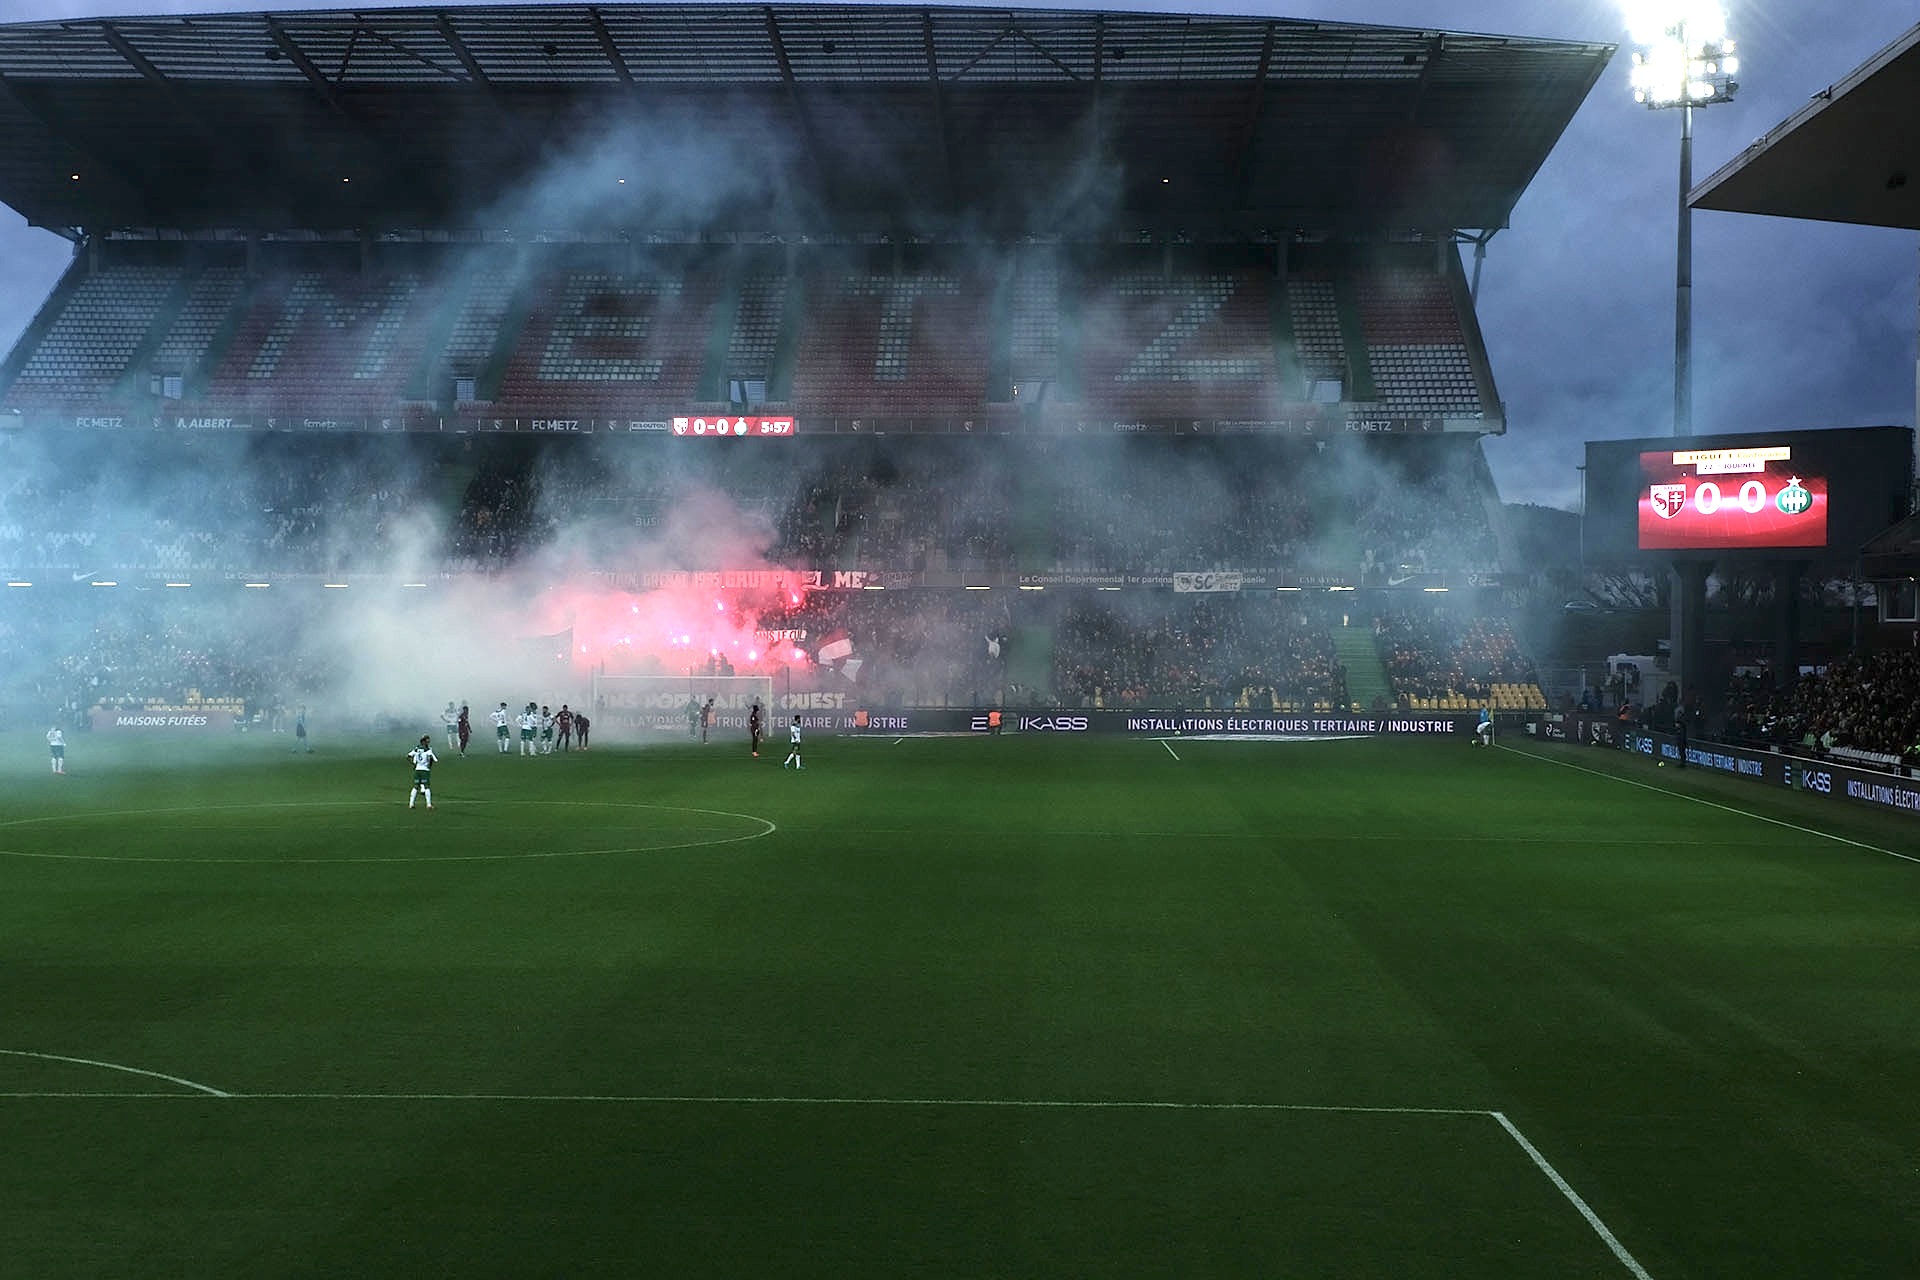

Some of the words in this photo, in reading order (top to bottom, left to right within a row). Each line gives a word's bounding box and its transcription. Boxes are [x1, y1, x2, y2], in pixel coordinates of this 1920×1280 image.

[76, 417, 90, 428] FC
[92, 417, 122, 428] METZ
[189, 418, 232, 428] ALBERT
[531, 421, 547, 432] FC
[549, 421, 578, 432] METZ
[760, 421, 790, 432] 5:57
[1345, 422, 1360, 431] FC
[1361, 422, 1391, 431] METZ
[1031, 575, 1062, 583] Conseil
[1193, 576, 1212, 589] SC
[780, 693, 846, 709] OUEST
[116, 717, 166, 726] MAISONS
[168, 715, 207, 726] FUTÉES
[1127, 719, 1223, 731] INSTALLATIONS
[1227, 716, 1309, 731] ÉLECTRIQUES
[1312, 720, 1376, 731] TERTIAIRE
[1388, 721, 1454, 732] INDUSTRIE
[1847, 779, 1894, 805] INSTALLATIONS
